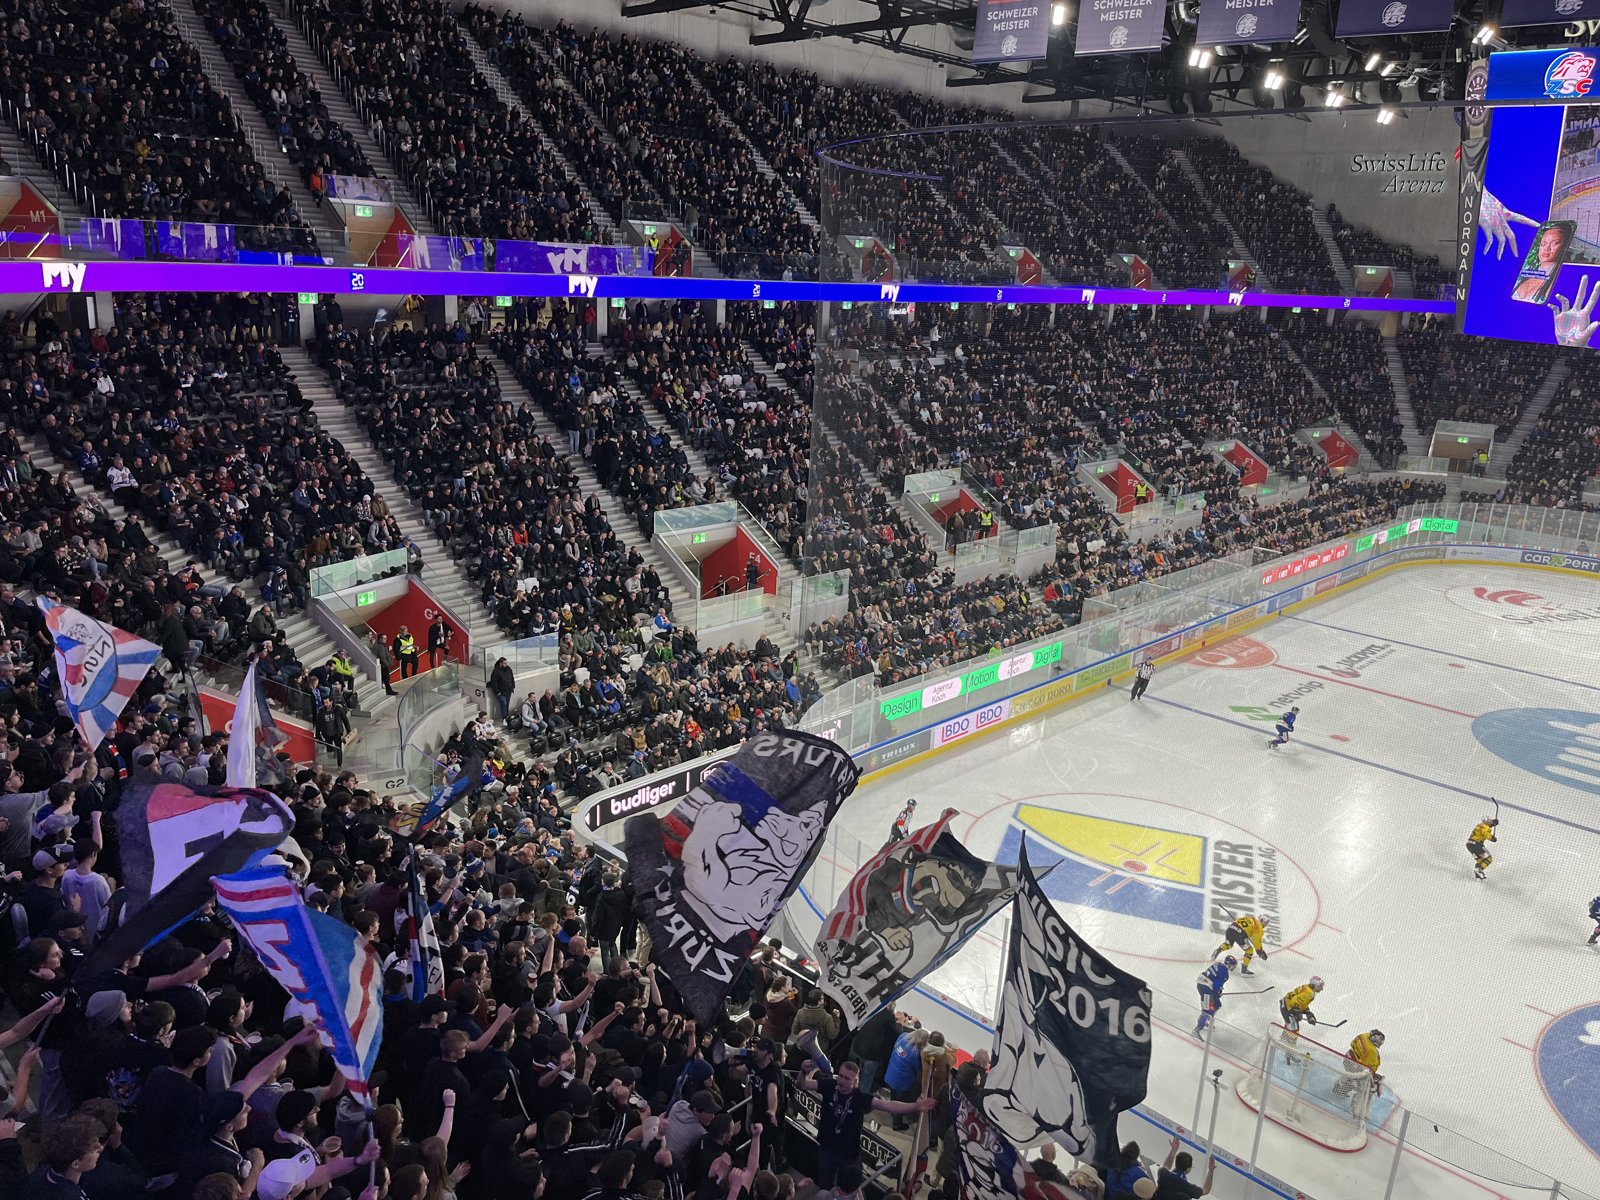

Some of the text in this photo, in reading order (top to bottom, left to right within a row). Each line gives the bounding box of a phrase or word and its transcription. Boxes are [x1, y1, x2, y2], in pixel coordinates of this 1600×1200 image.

[1225, 0, 1274, 10] MEISTER
[987, 6, 1039, 21] SCHWEIZER
[1100, 9, 1143, 22] MEISTER
[993, 20, 1030, 32] MEISTER
[1543, 79, 1594, 95] ZSC
[1350, 152, 1447, 173] SwissLife
[1382, 175, 1446, 194] Arena
[29, 210, 46, 223] M1
[1456, 195, 1474, 301] NORQAIN
[41, 262, 87, 293] My
[568, 275, 598, 298] My
[1127, 478, 1138, 487] F2
[749, 552, 761, 564] F4
[1007, 557, 1016, 565] F3
[781, 612, 791, 621] F4
[965, 670, 995, 690] Motion
[474, 688, 486, 699] G1
[932, 682, 954, 695] Agentur
[883, 696, 918, 718] Design
[979, 705, 1003, 725] BDO
[945, 718, 970, 738] BDO
[881, 743, 916, 761] TRILUX
[385, 778, 405, 790] G2
[610, 780, 677, 816] budliger
[1049, 966, 1152, 1044] 2016
